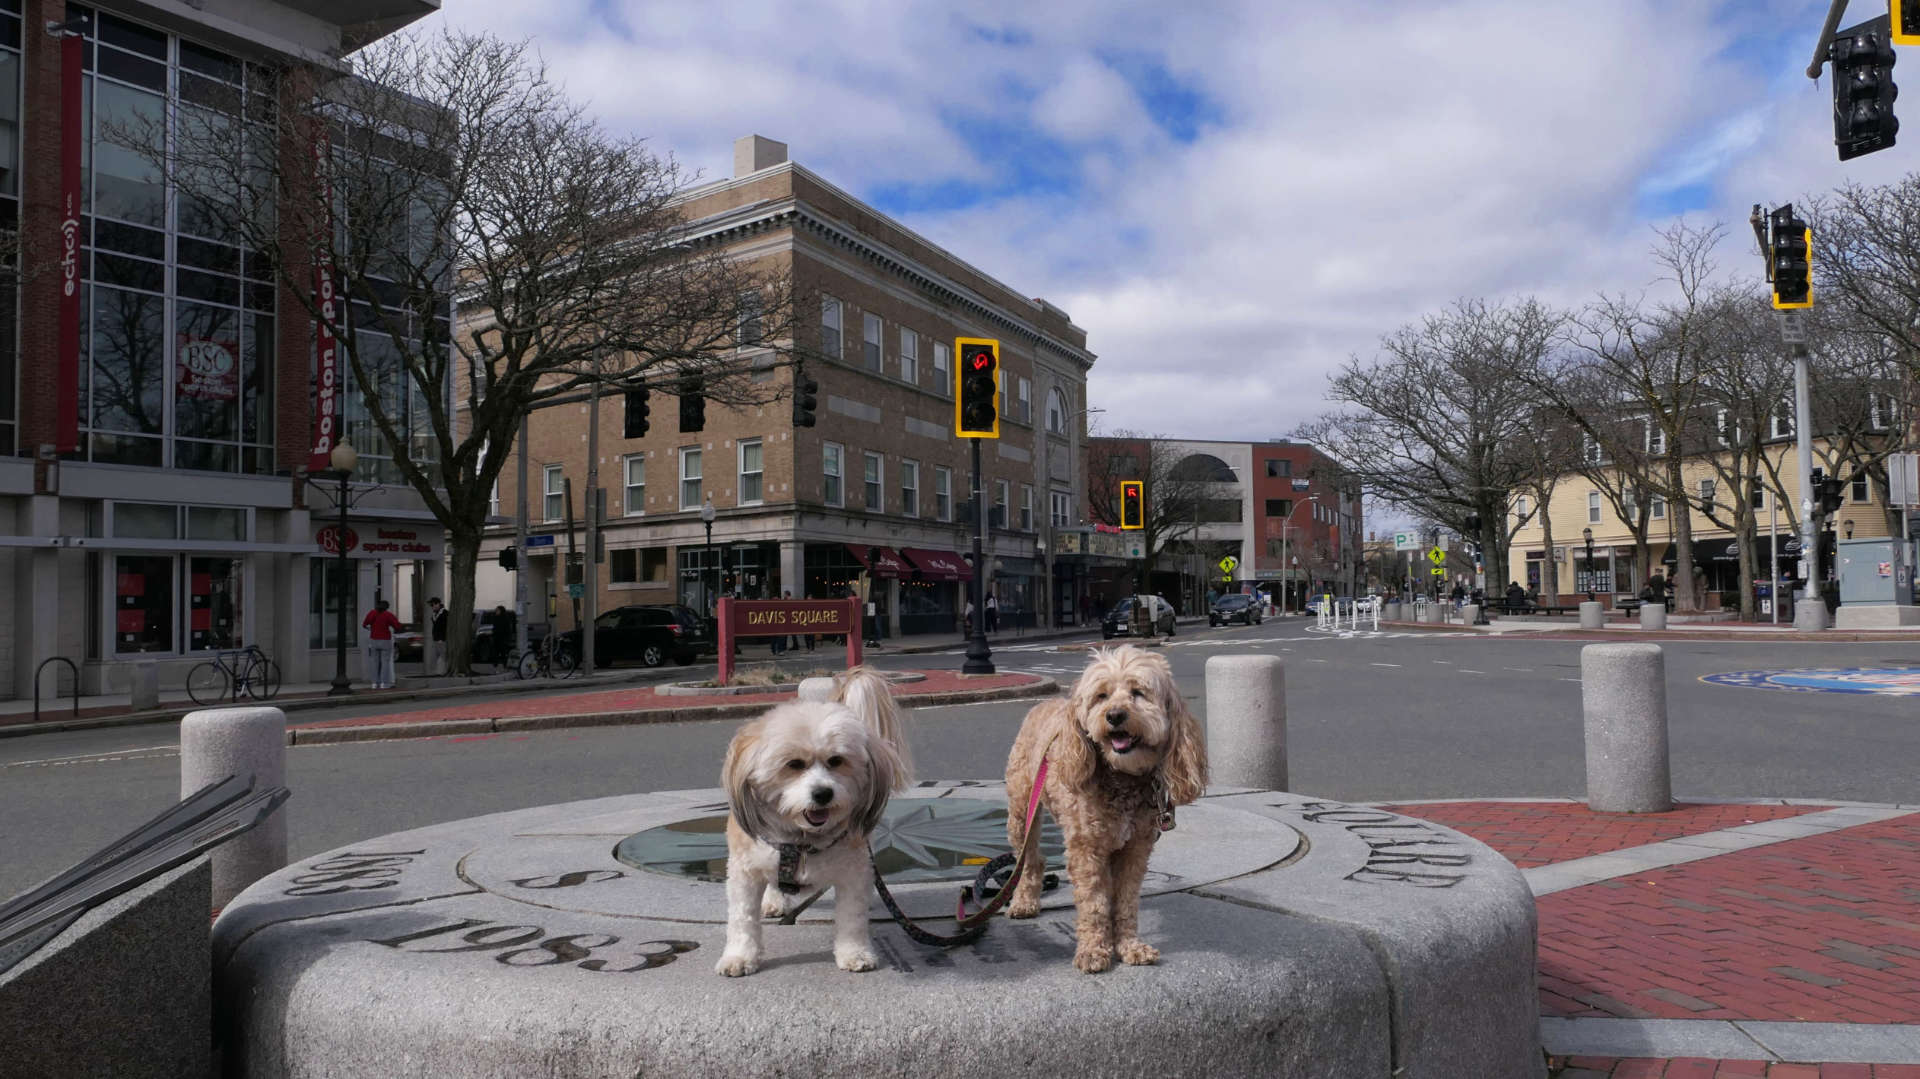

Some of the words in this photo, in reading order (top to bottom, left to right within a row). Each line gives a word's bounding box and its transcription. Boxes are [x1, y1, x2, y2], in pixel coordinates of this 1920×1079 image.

[188, 345, 225, 372] BSC
[313, 348, 334, 456] boston
[362, 542, 400, 554] sports
[748, 610, 786, 625] DAVIS
[791, 609, 839, 626] SQUARE
[1265, 802, 1473, 889] SQUARE
[283, 848, 426, 897] 1883
[364, 917, 701, 974] 1983
